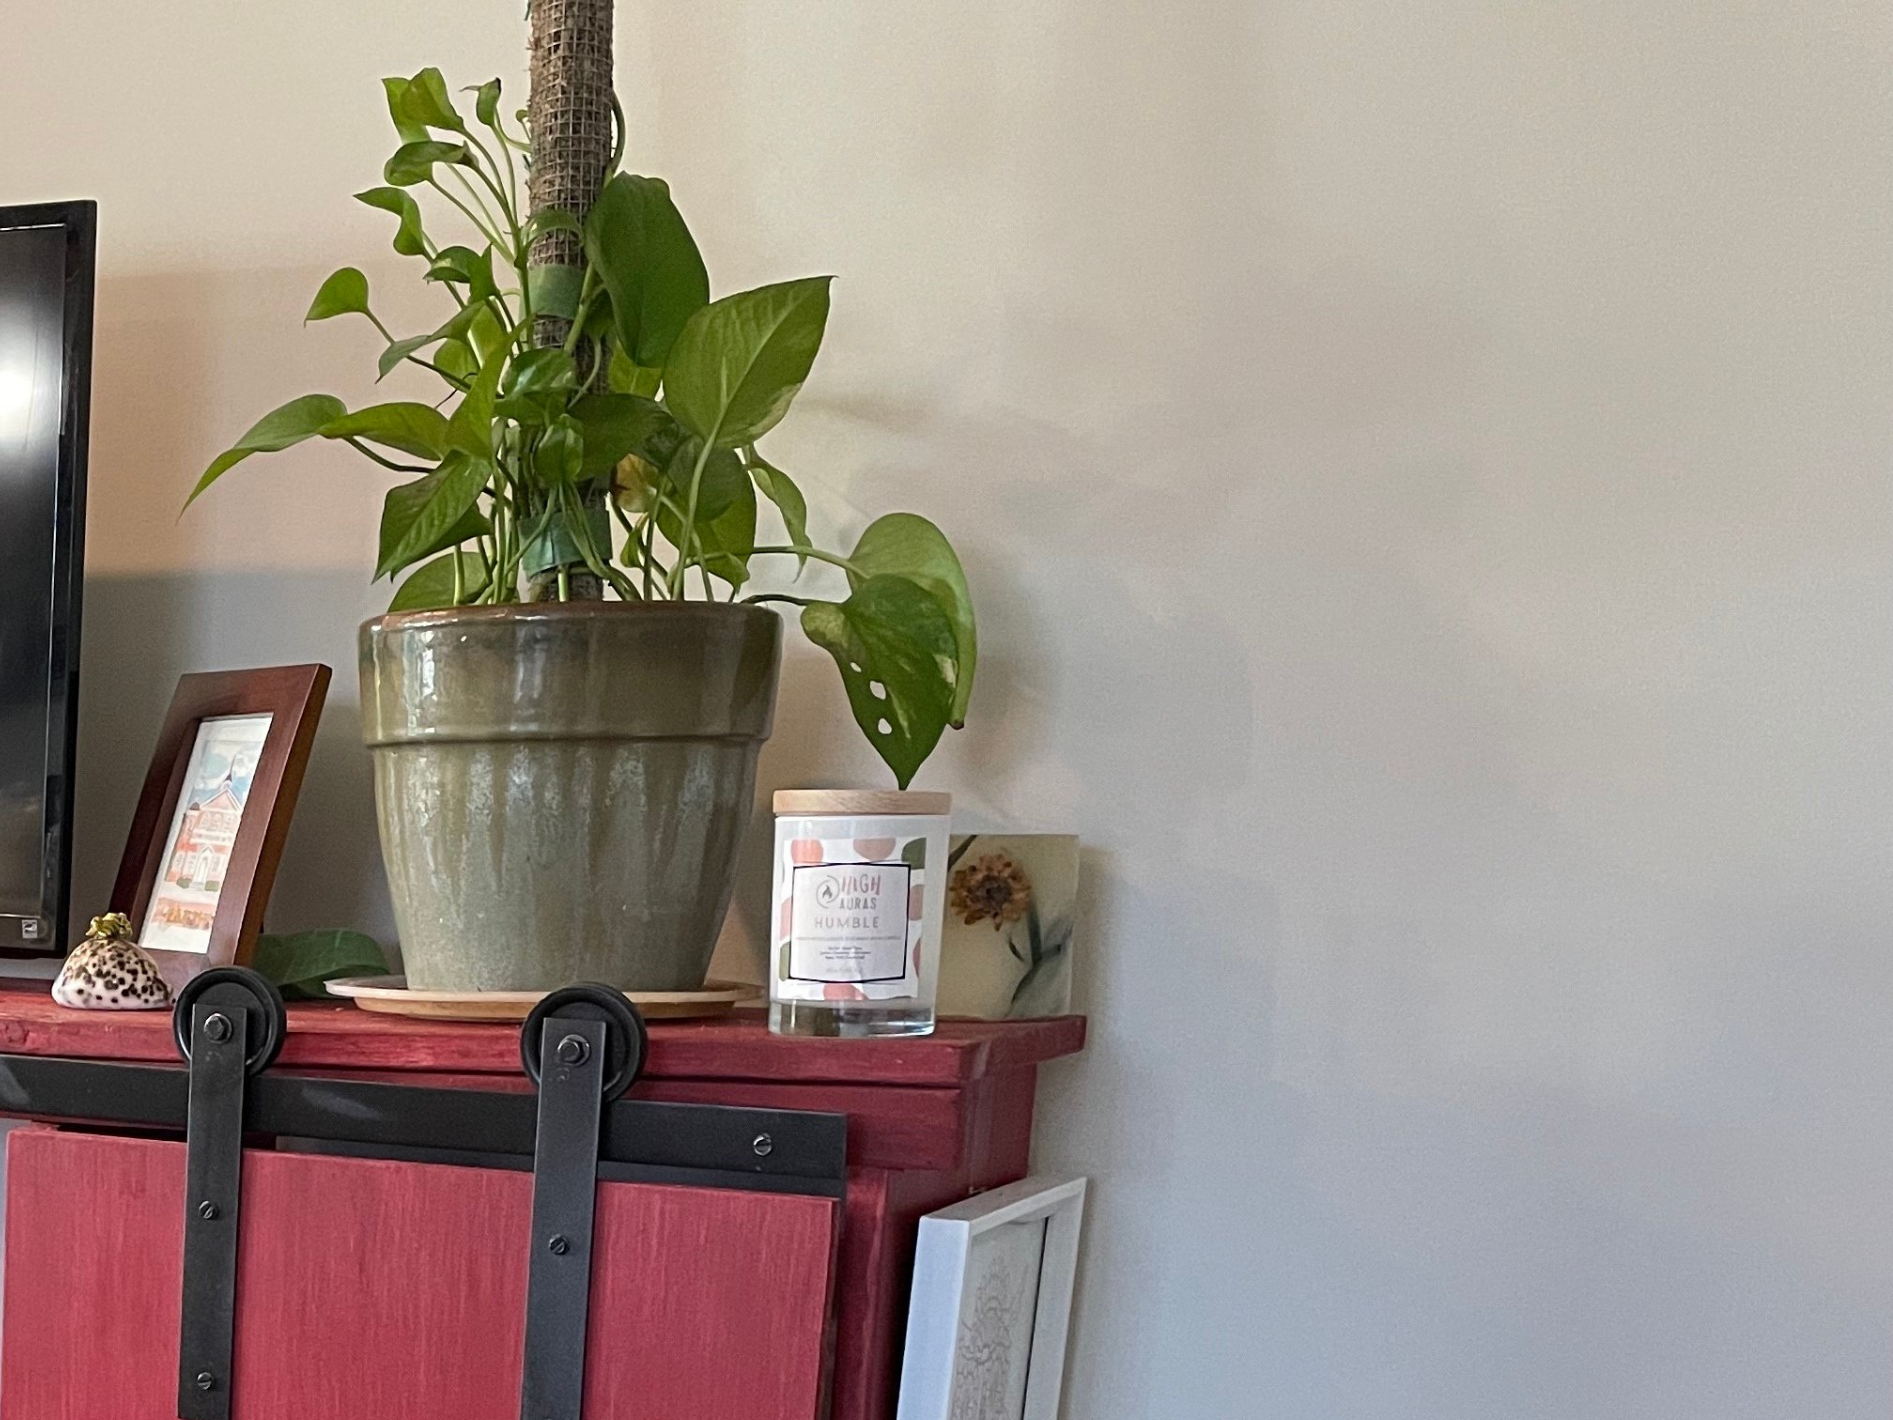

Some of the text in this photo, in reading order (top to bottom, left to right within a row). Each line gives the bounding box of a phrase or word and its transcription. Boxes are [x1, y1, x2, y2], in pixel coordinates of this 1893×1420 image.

[841, 874, 881, 895] HIGH
[839, 897, 877, 910] AURAS
[814, 916, 879, 929] HUMBLE
